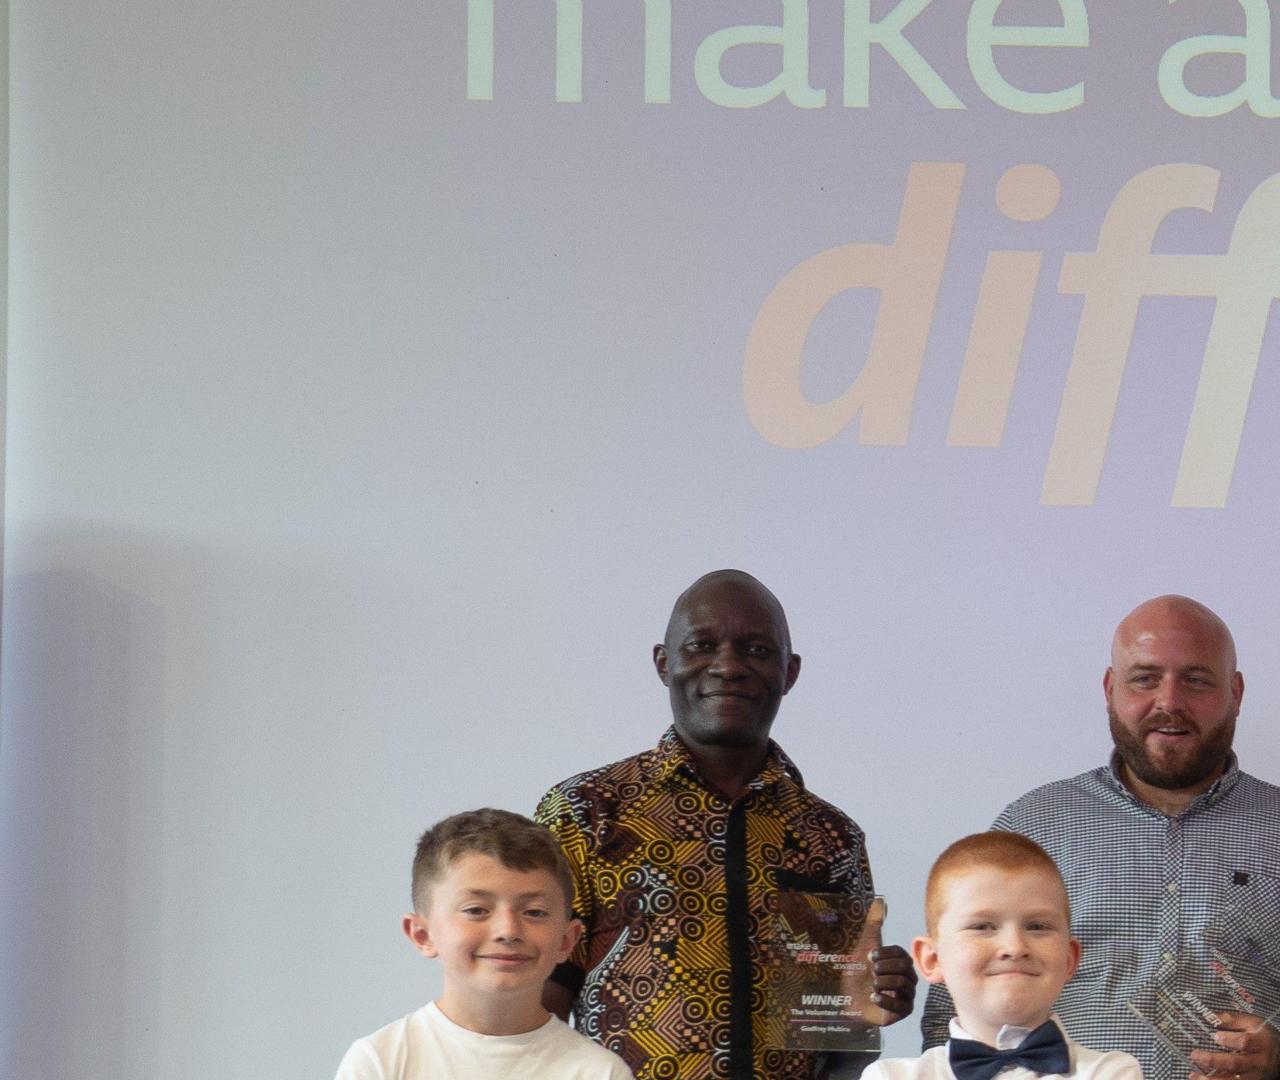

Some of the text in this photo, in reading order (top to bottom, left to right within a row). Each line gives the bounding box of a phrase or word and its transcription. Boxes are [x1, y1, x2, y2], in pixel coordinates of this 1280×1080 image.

[461, 0, 1090, 114] make
[796, 950, 860, 963] difference
[801, 994, 852, 1006] WINNER
[1182, 990, 1222, 1028] WINNER
